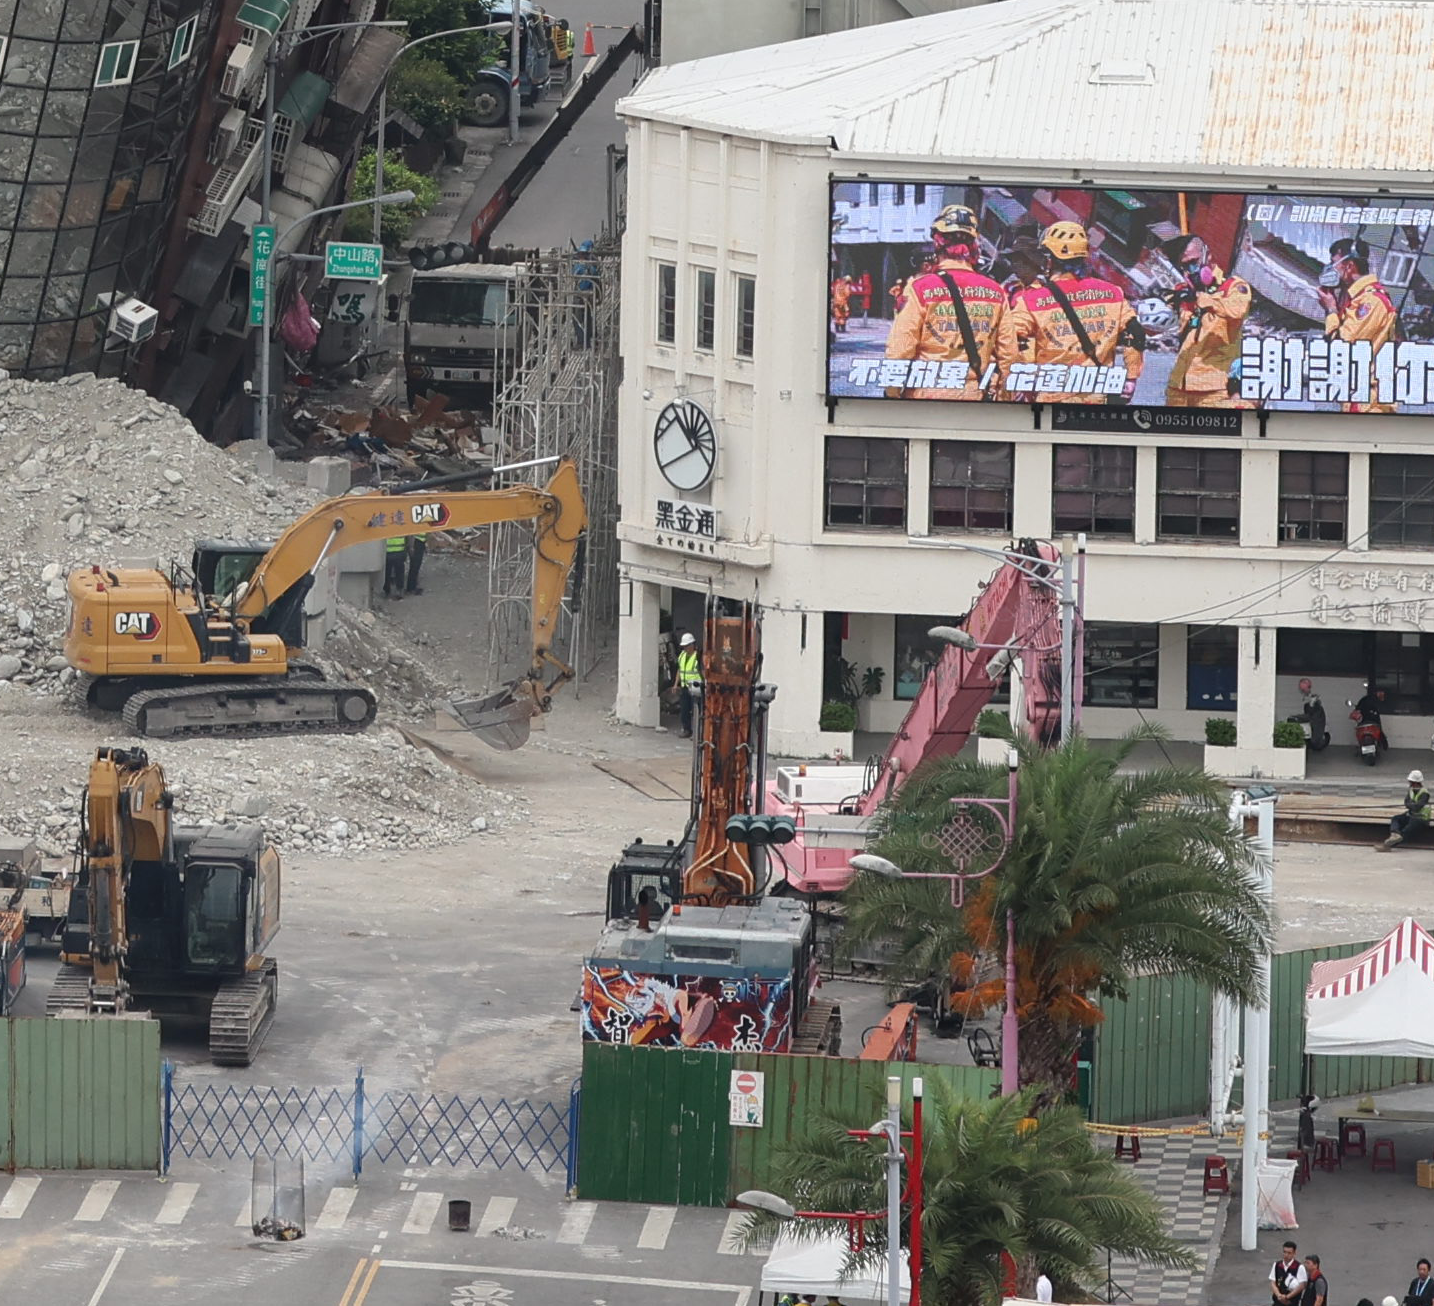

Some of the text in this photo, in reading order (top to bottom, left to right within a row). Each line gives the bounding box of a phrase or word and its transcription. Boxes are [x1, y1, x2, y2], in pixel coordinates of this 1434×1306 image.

[333, 248, 375, 263] 中山路
[847, 358, 971, 389] 不要放棄
[1005, 363, 1128, 394] 花蓮加油
[1155, 414, 1238, 429] 0955109812
[411, 502, 441, 524] CAT
[655, 499, 715, 539] 黑金通
[114, 611, 151, 635] CAT
